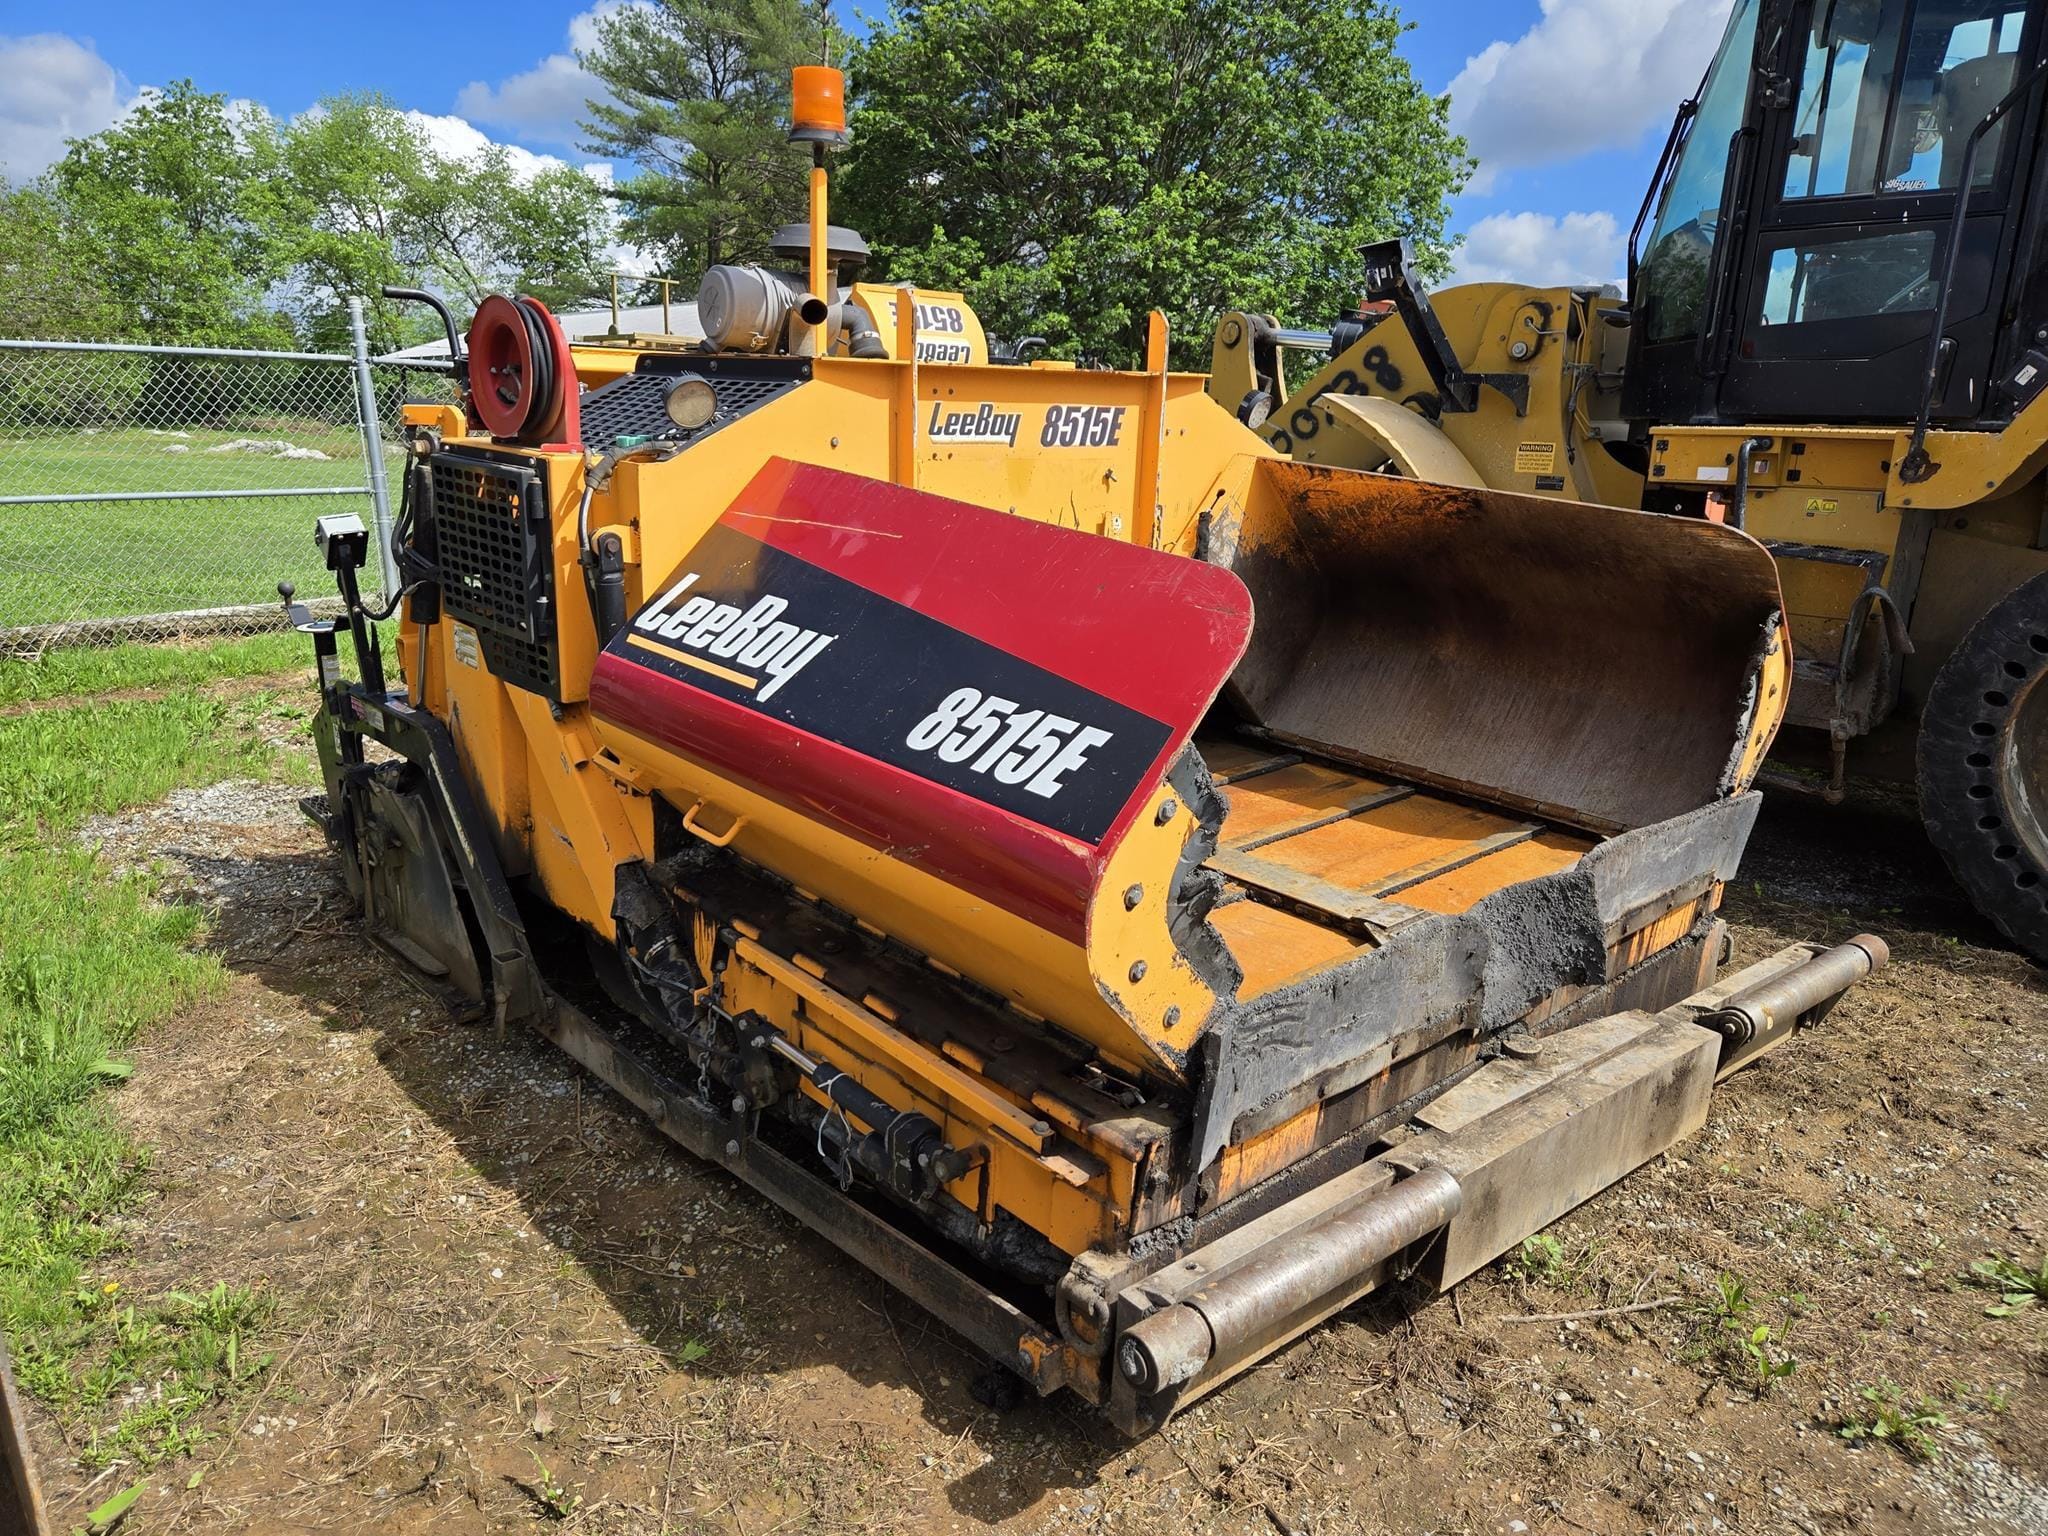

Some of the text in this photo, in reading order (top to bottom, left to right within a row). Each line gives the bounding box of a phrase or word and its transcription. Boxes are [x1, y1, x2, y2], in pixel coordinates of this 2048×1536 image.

[928, 402, 1126, 448] LeeBoy 8515E
[1520, 444, 1552, 452] WARNING
[634, 572, 835, 703] LeeBoy
[905, 687, 1114, 799] 8515E
